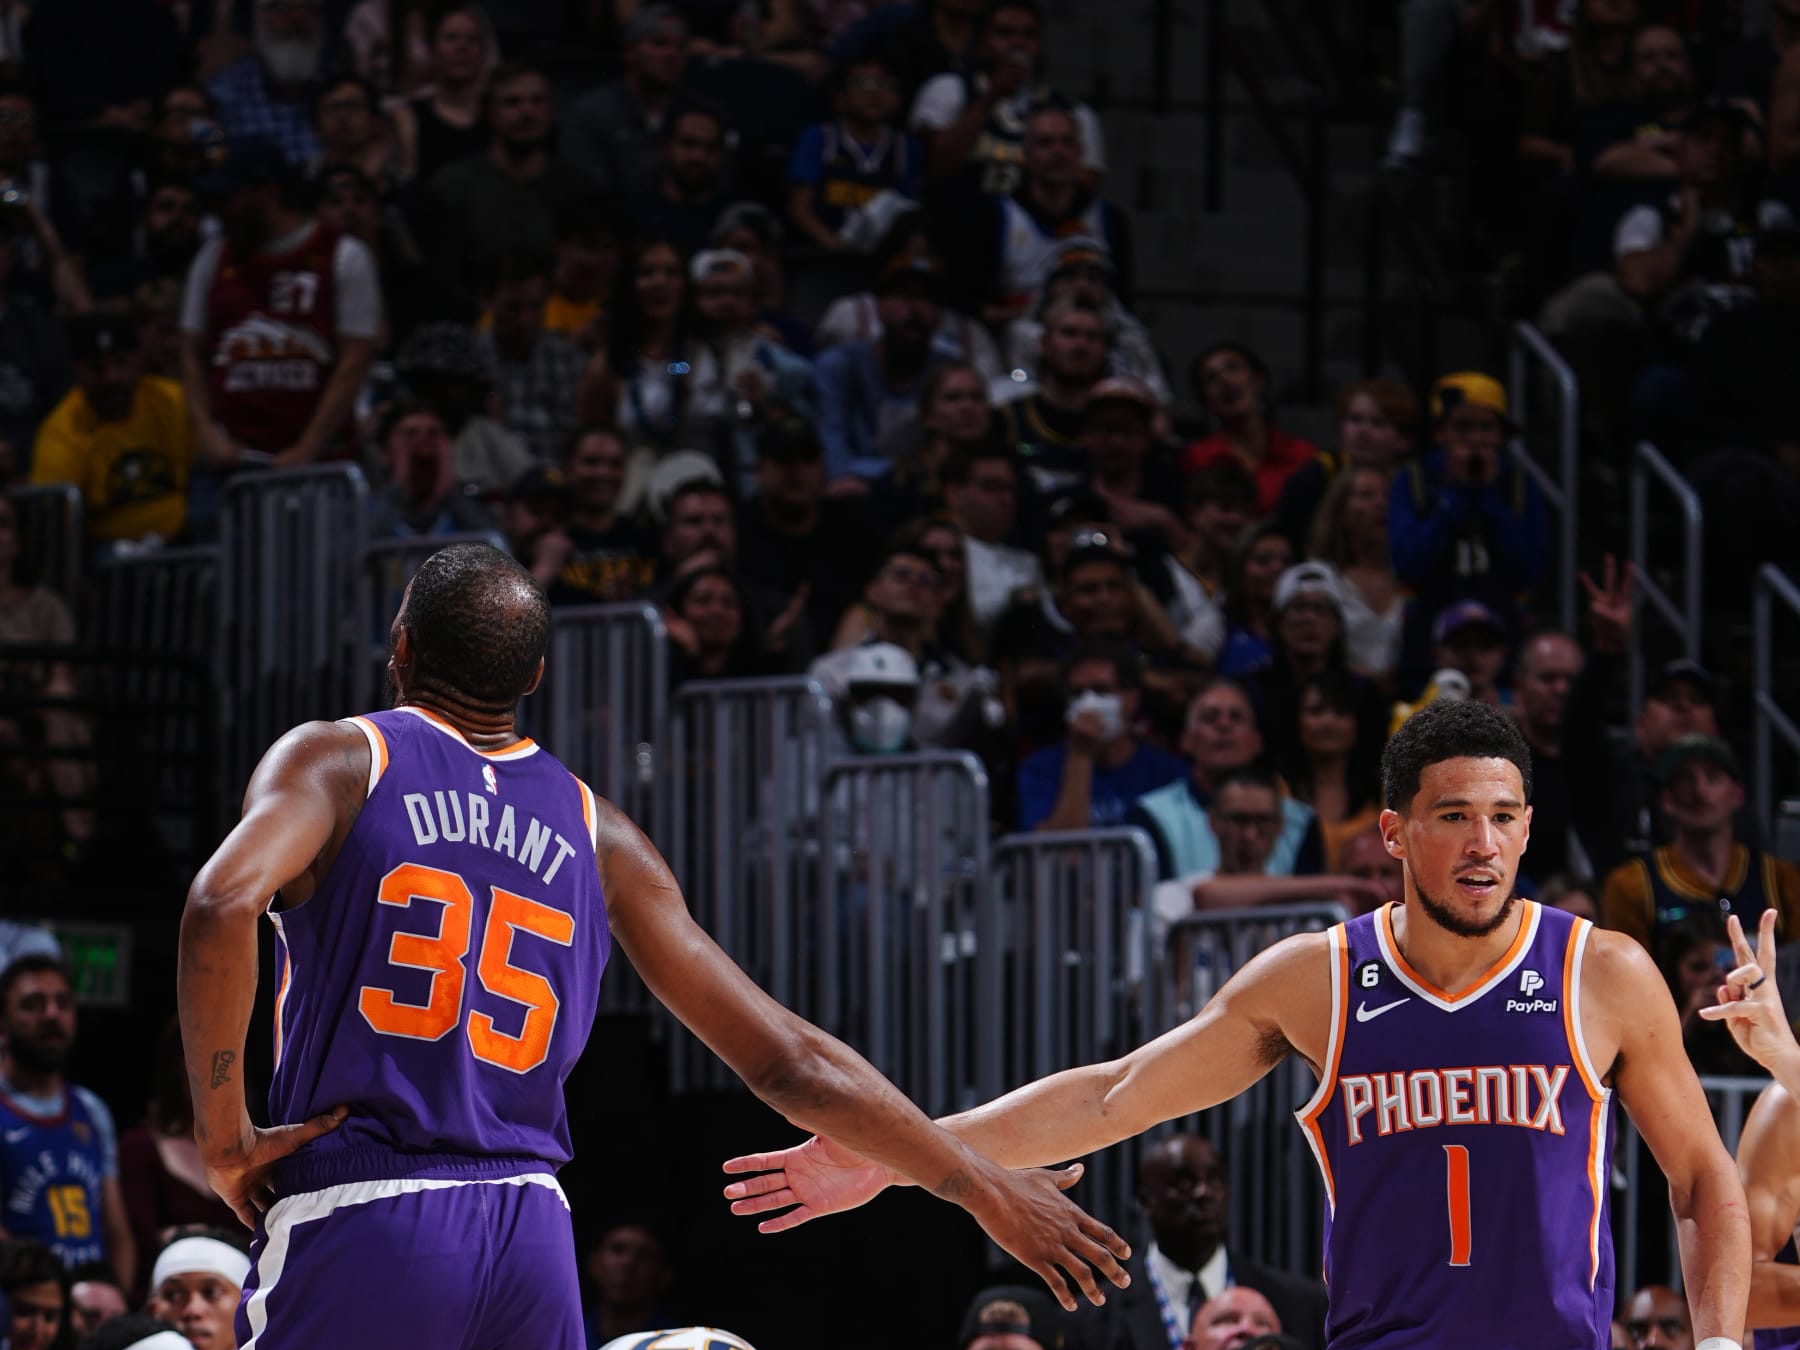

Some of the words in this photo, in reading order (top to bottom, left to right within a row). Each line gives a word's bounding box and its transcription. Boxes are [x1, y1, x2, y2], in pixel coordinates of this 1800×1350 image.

[403, 790, 575, 886] DURANT
[358, 861, 575, 1075] 35
[1361, 963, 1378, 989] 6
[1506, 999, 1557, 1014] PayPal
[1339, 1064, 1570, 1147] PHOENIX
[46, 1183, 92, 1240] 15
[1441, 1144, 1471, 1266] 1
